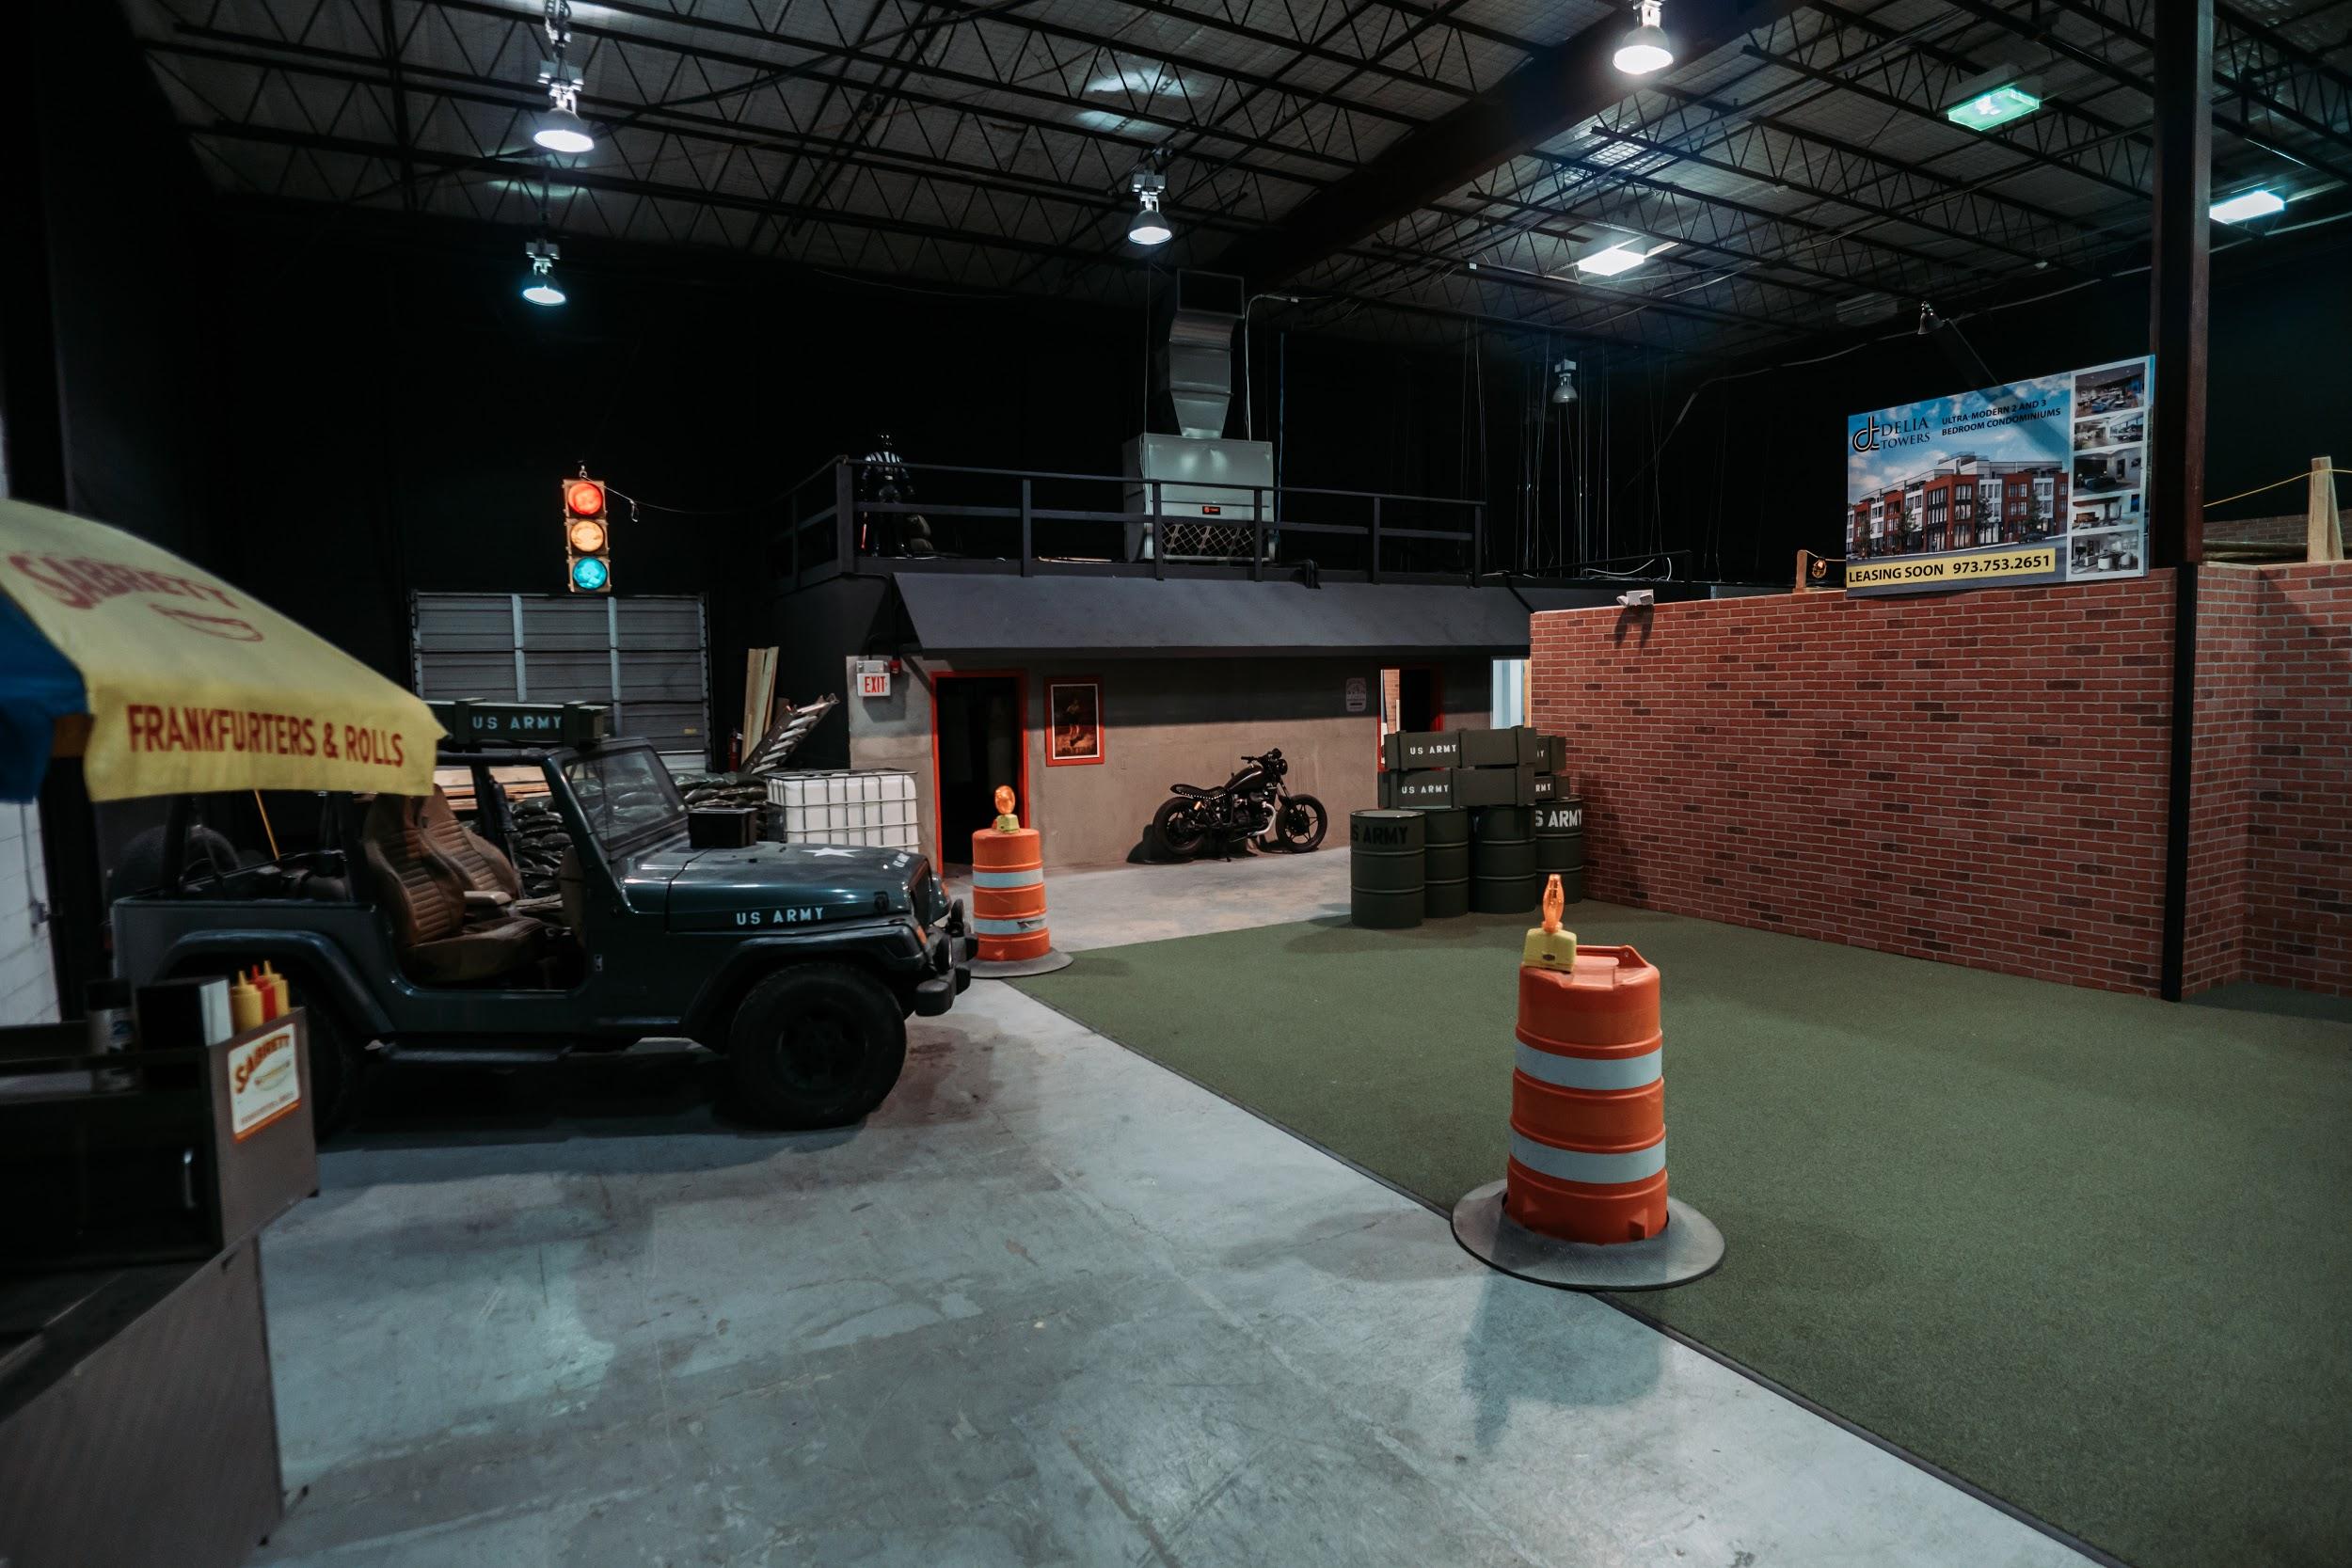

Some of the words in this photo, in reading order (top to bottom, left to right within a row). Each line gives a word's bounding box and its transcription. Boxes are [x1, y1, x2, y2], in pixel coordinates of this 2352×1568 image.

[1941, 420, 1985, 436] BEDROOM
[1986, 407, 2061, 427] CONDOMINIUMS
[1942, 405, 2010, 425] ULTRA-MODERN
[2019, 401, 2039, 411] AND
[1882, 417, 1929, 436] DELIA
[1882, 433, 1931, 450] TOWERS
[1849, 567, 1901, 582] LEASING
[1904, 563, 1944, 578] SOON
[1952, 555, 2050, 574] 973.753.2651
[865, 675, 886, 693] EXIT
[472, 716, 498, 730] US
[510, 716, 562, 730] ARMY
[126, 704, 316, 757] FRANKFURTERS
[323, 723, 339, 758] &
[344, 725, 404, 768] ROLLS
[1409, 746, 1423, 755] US
[1429, 744, 1457, 754] ARMY
[1402, 784, 1415, 794] US
[1421, 784, 1449, 794] ARMY
[1535, 783, 1551, 793] RMY
[1535, 810, 1544, 827] S
[1548, 808, 1582, 828] ARMY
[1363, 826, 1408, 845] ARMY
[736, 911, 761, 926] US
[772, 907, 824, 924] ARMY
